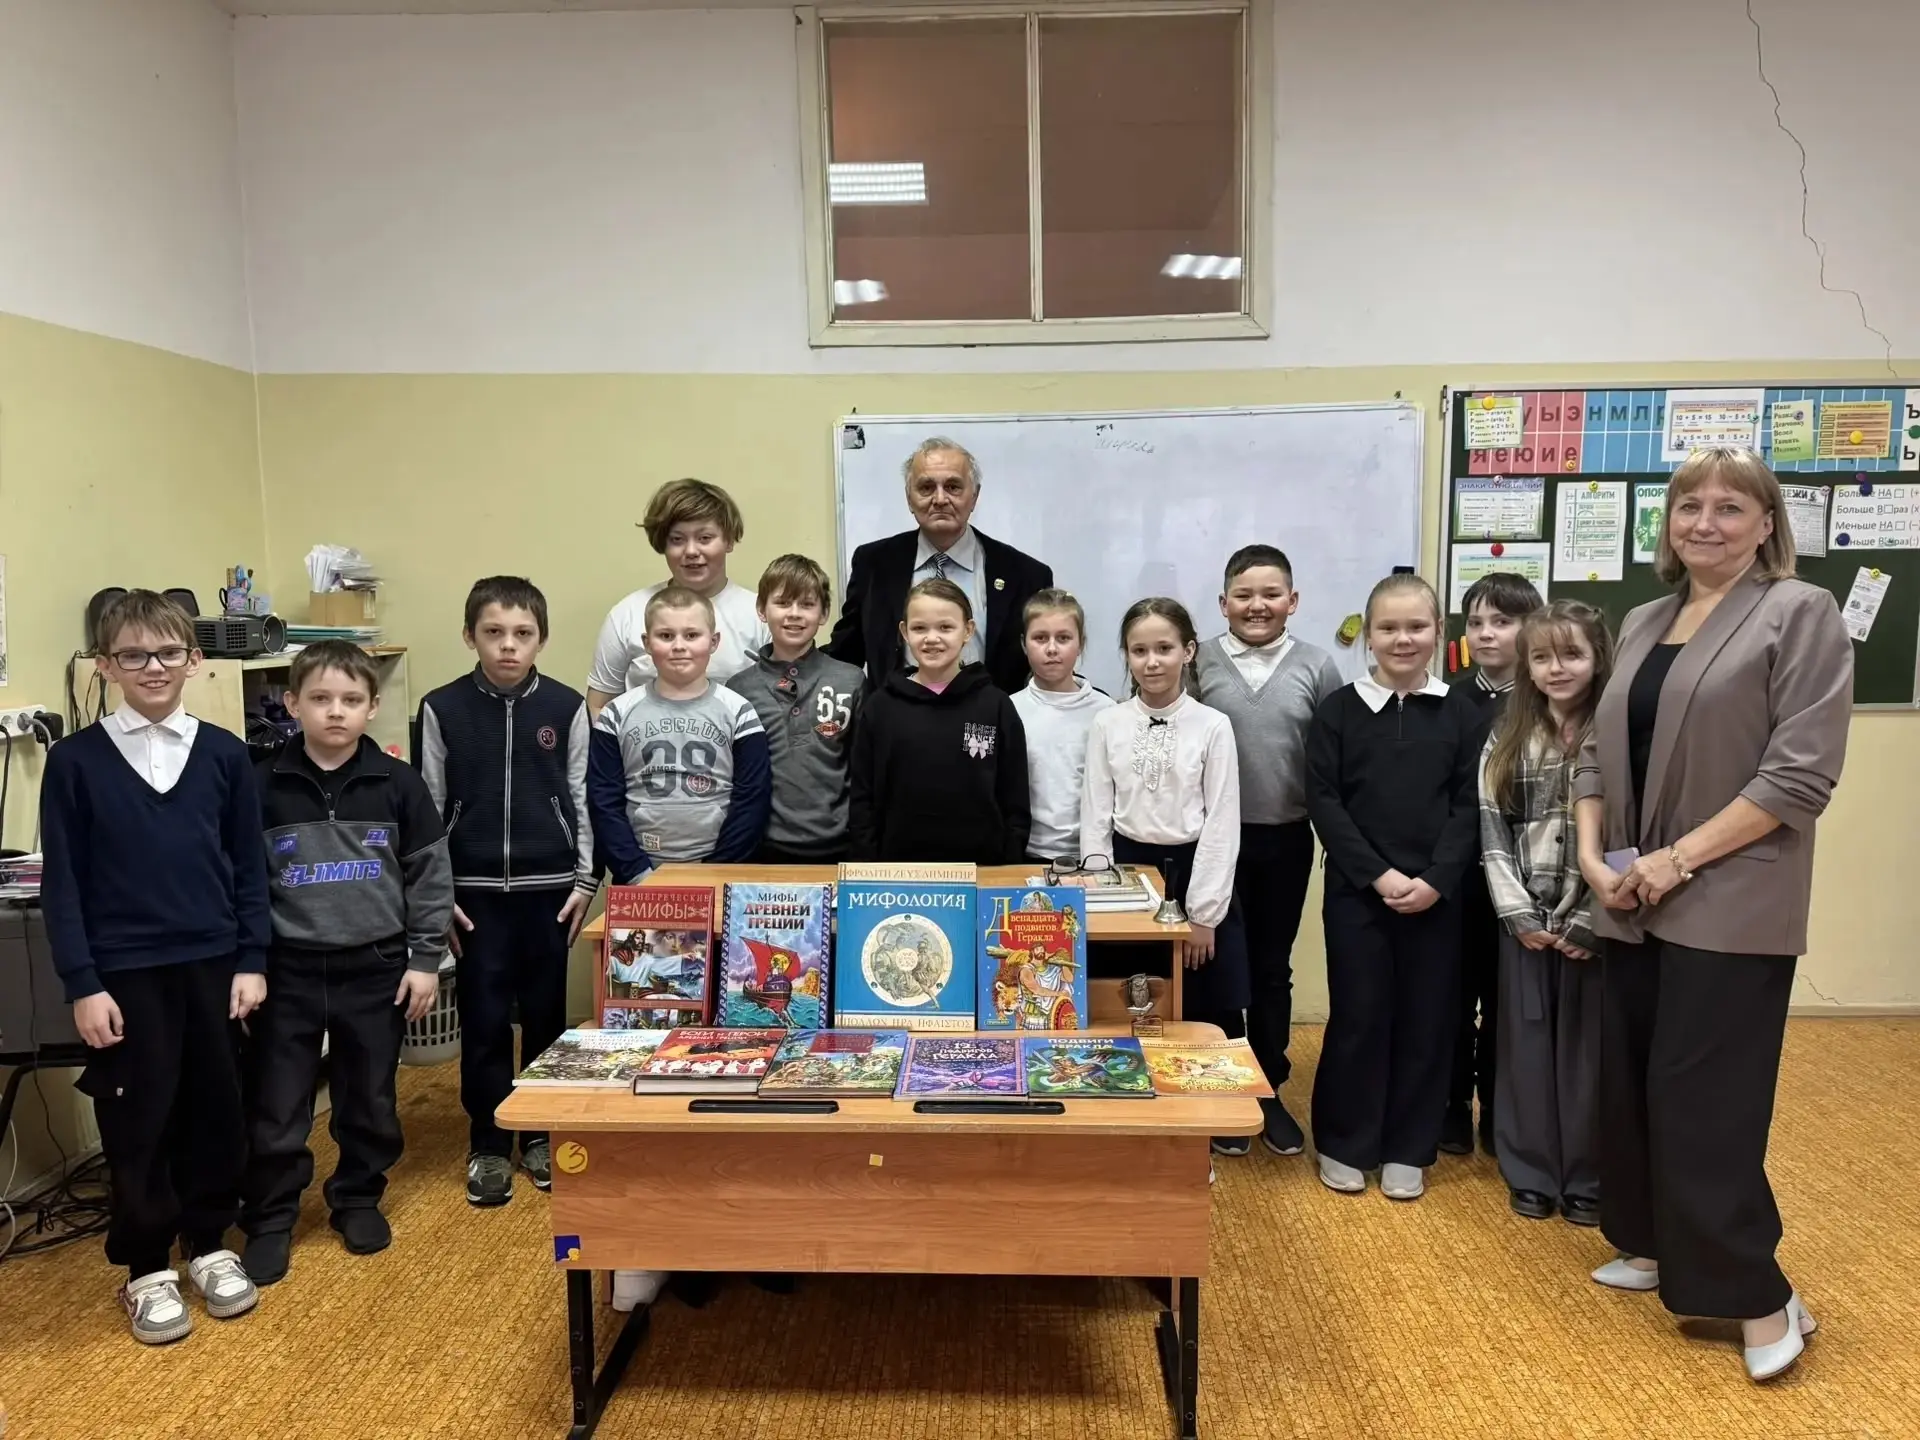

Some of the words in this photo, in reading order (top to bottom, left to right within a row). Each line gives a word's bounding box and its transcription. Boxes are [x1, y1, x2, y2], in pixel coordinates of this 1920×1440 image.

[1838, 489, 1875, 497] Болье
[1837, 505, 1874, 514] Больше
[1835, 522, 1877, 530] Меньше
[817, 686, 852, 731] 65
[629, 718, 727, 747] FASCLUB
[757, 892, 798, 902] МИФЫ
[848, 892, 967, 910] МИФОЛОГИЯ
[631, 902, 687, 919] МИФЫ
[743, 903, 811, 916] ДРЕВНЕЙ
[748, 917, 805, 929] ГРЕЦИИ
